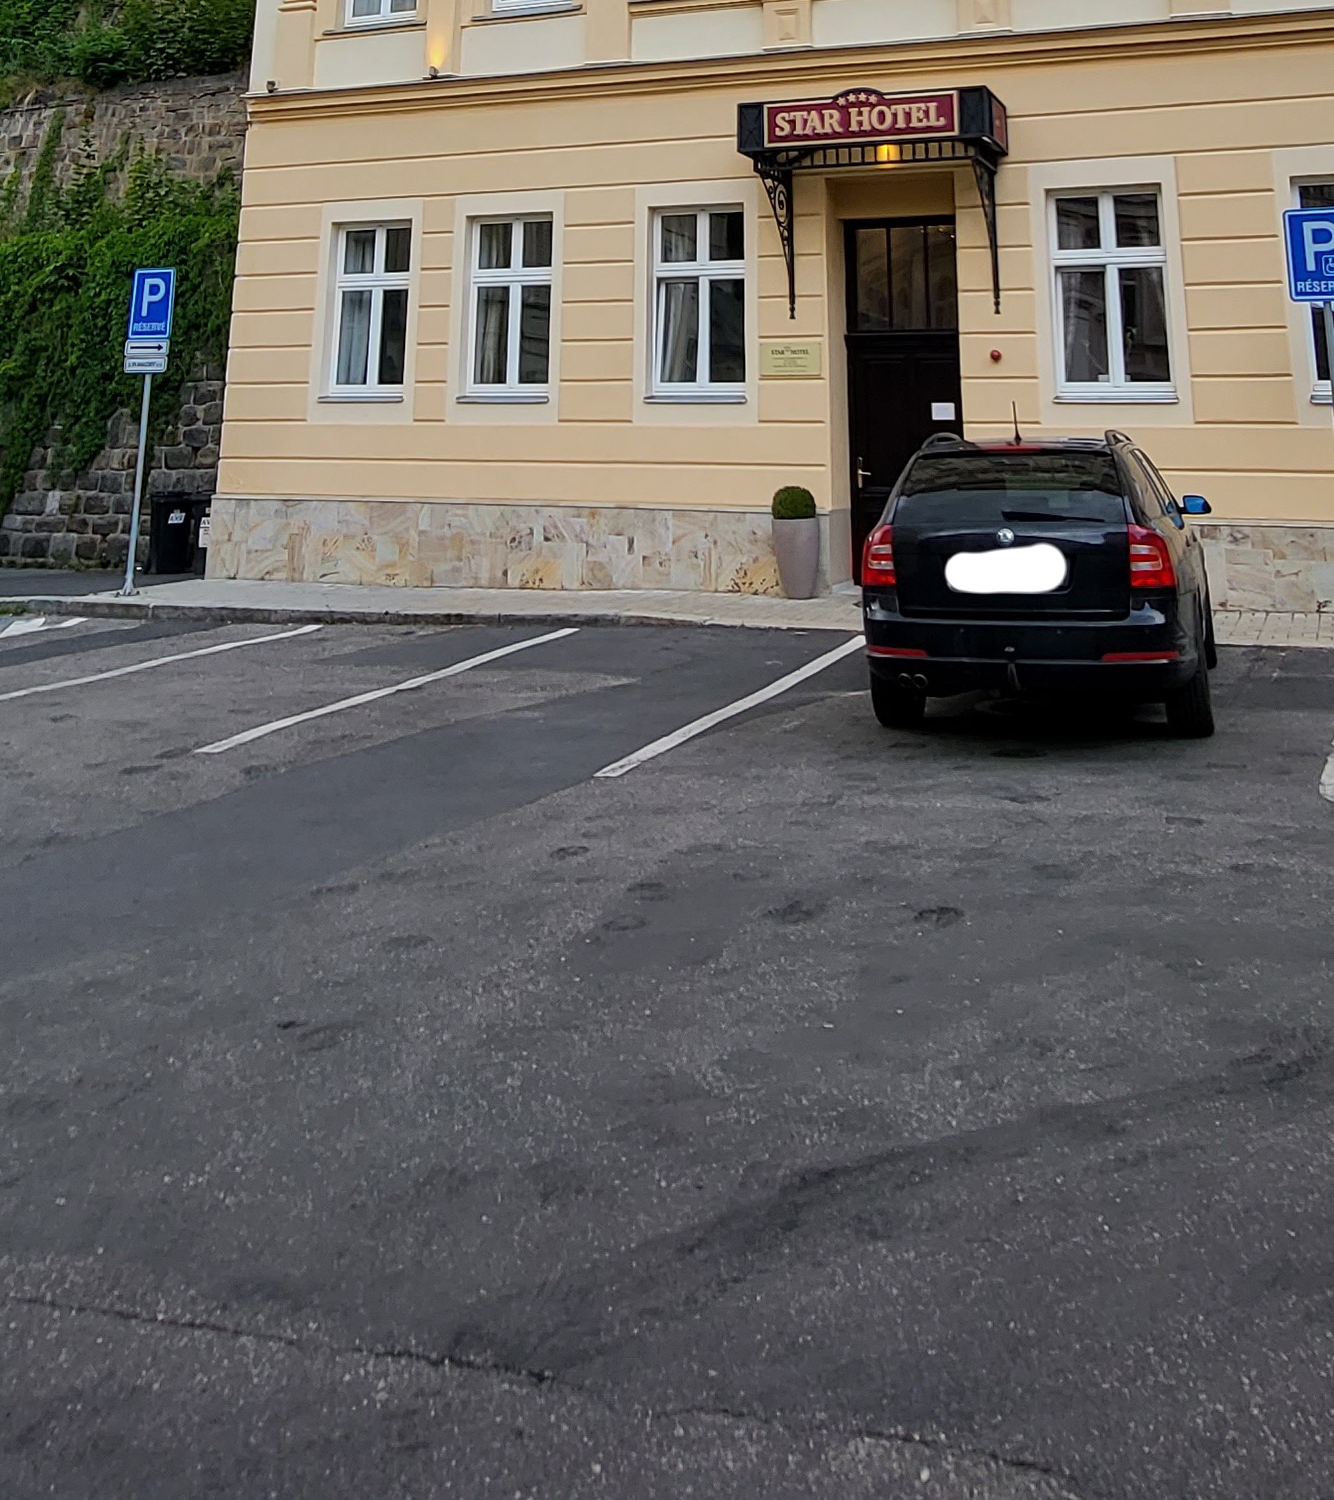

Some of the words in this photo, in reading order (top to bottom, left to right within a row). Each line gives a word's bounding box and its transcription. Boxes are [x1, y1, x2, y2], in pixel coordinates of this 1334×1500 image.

[775, 108, 844, 136] STAR
[848, 101, 947, 132] HOTEL
[141, 278, 166, 317] P
